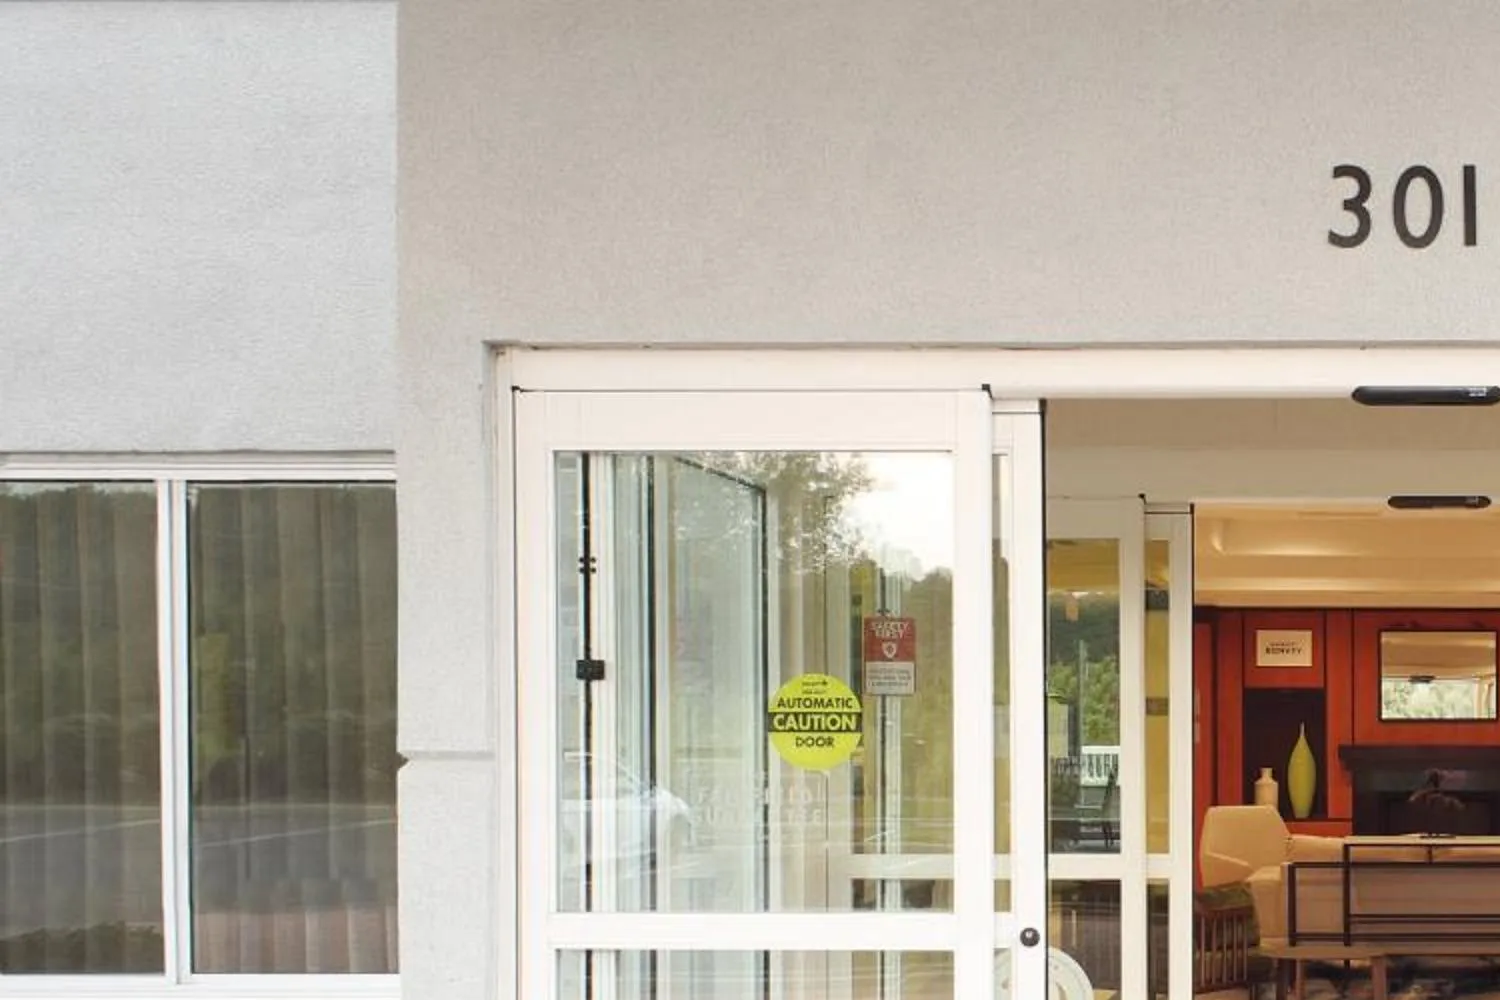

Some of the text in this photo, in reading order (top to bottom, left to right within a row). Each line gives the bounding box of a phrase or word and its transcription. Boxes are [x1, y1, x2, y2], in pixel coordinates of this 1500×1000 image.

[1327, 164, 1477, 249] 301
[777, 697, 853, 709] AUTOMATIC
[773, 713, 857, 731] CAUTION
[795, 736, 834, 748] DOOR
